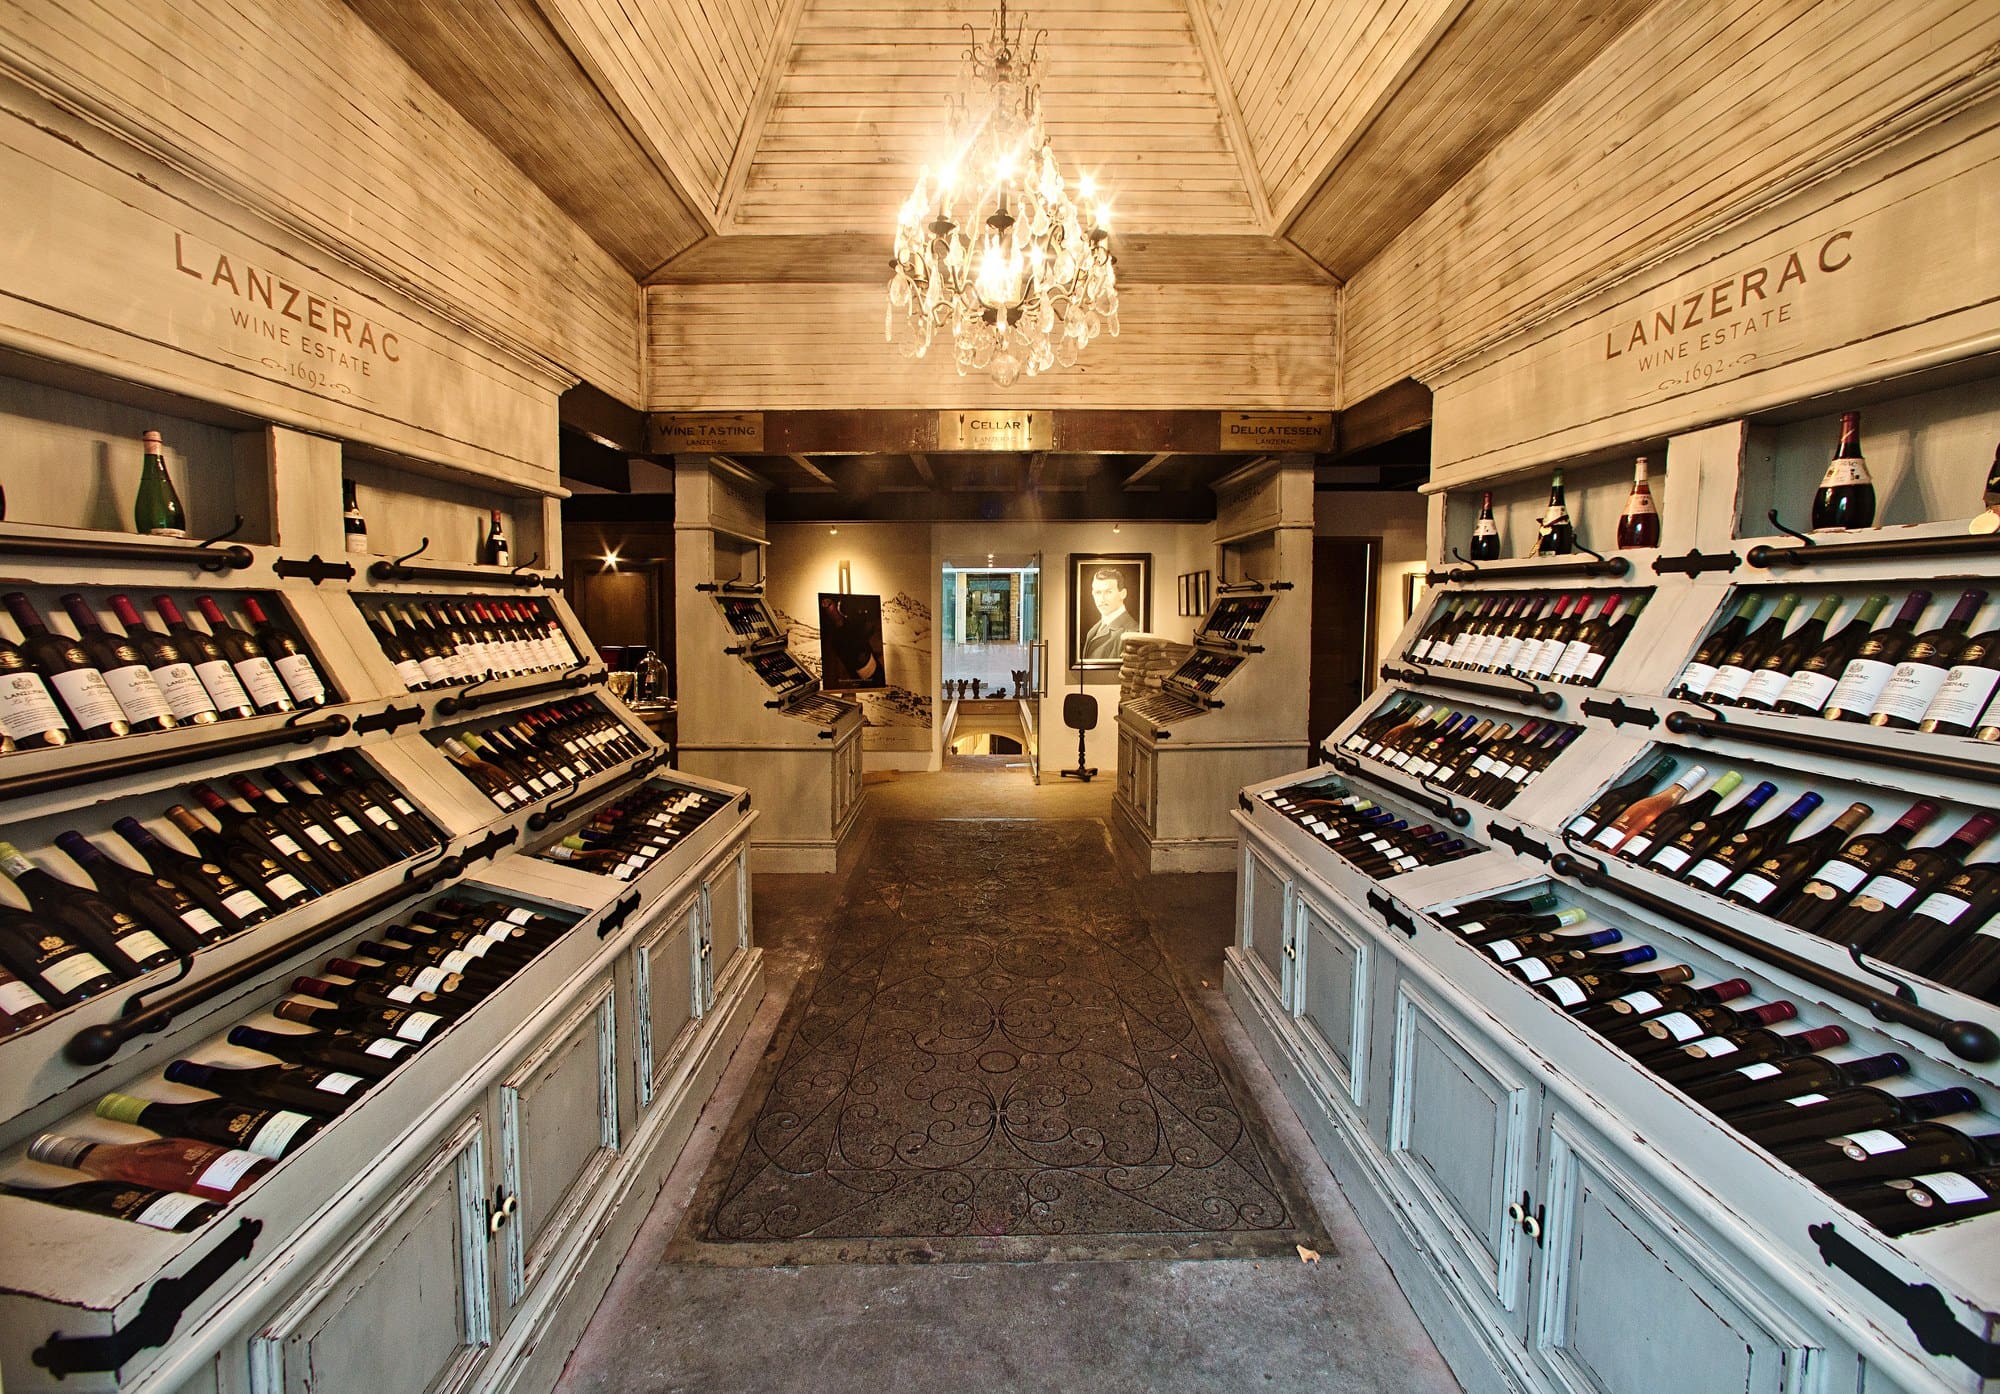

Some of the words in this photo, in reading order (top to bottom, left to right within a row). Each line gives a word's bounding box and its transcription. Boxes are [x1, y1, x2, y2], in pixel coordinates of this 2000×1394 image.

[174, 232, 400, 362] LANZERAC
[1606, 231, 1853, 361] LANZERAC
[230, 307, 291, 346] WINE
[302, 337, 371, 377] ESTATE
[1638, 341, 1689, 372] WINE
[1700, 303, 1792, 351] ESTATE
[289, 362, 326, 389] 1692
[1684, 359, 1724, 384] 1692
[660, 426, 695, 436] WINE
[698, 425, 756, 436] TASTING
[970, 420, 1021, 430] CELLAR
[1231, 425, 1322, 435] DELICATESSEN
